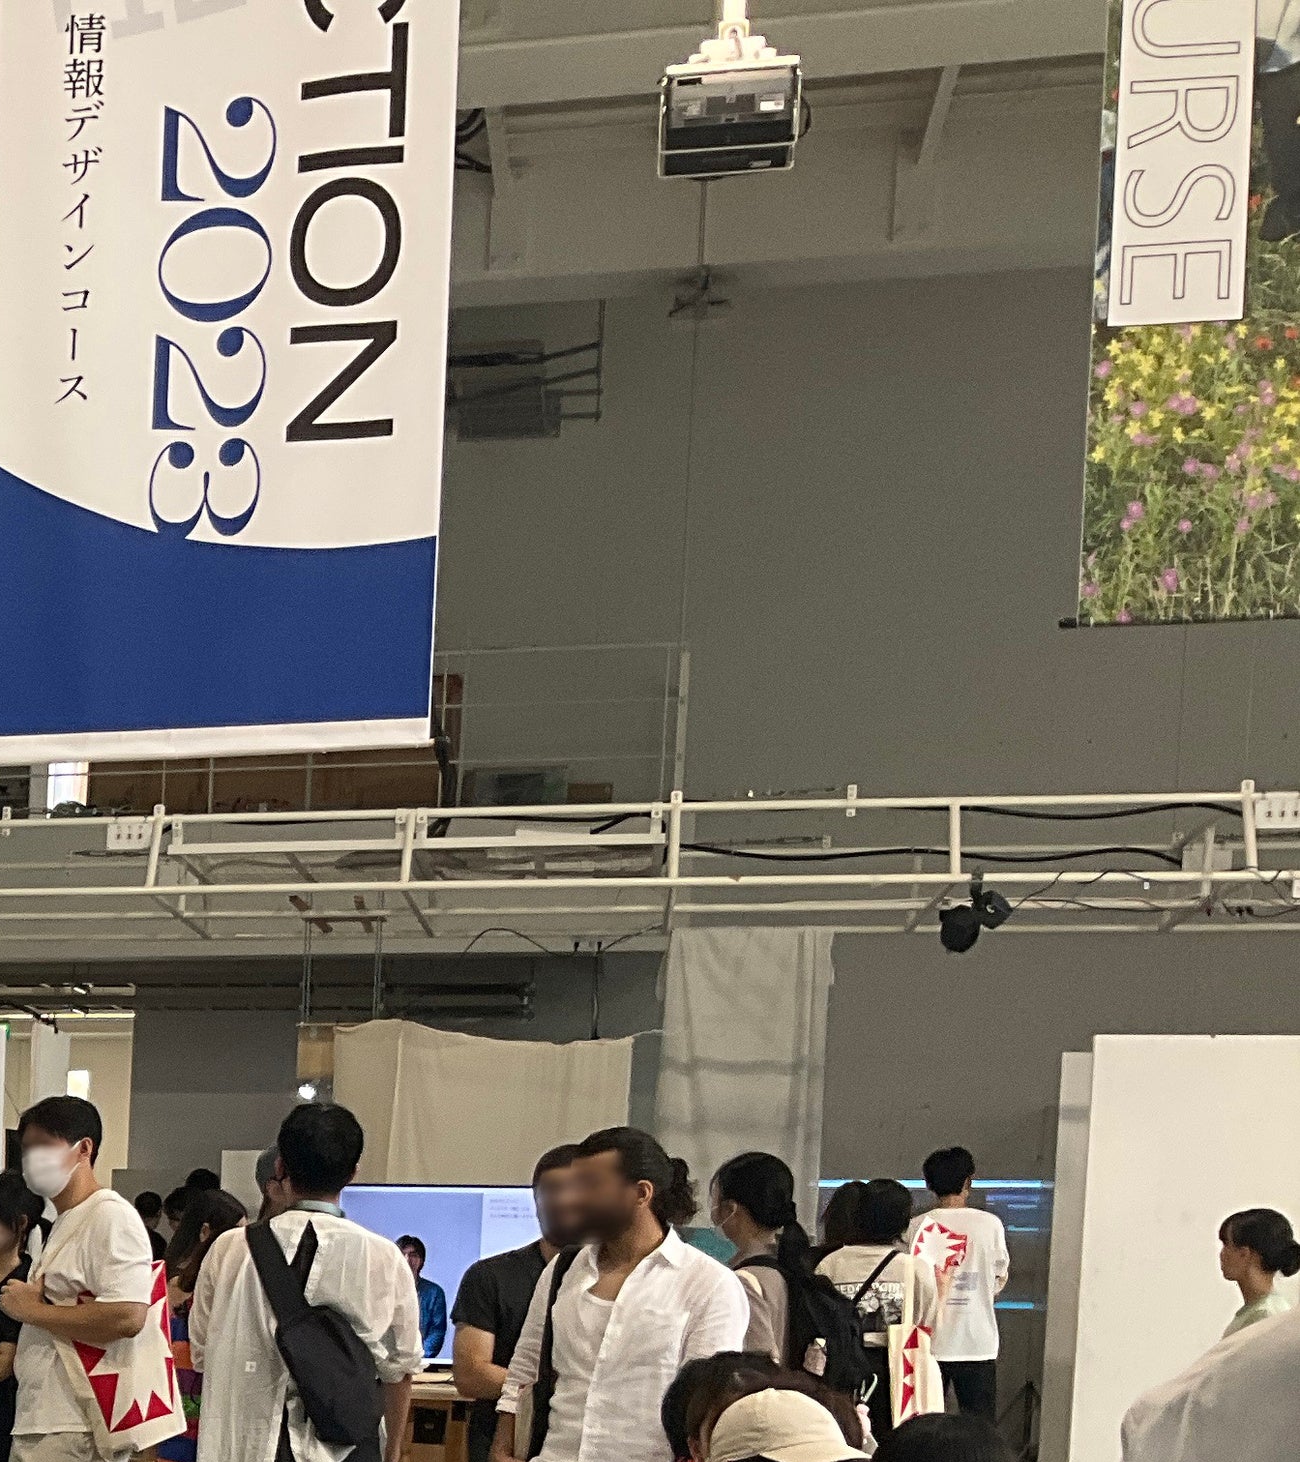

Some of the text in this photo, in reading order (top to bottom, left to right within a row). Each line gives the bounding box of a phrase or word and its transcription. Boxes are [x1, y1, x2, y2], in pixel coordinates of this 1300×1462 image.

[54, 13, 106, 404] 情報デザインコース
[148, 96, 277, 540] 2023
